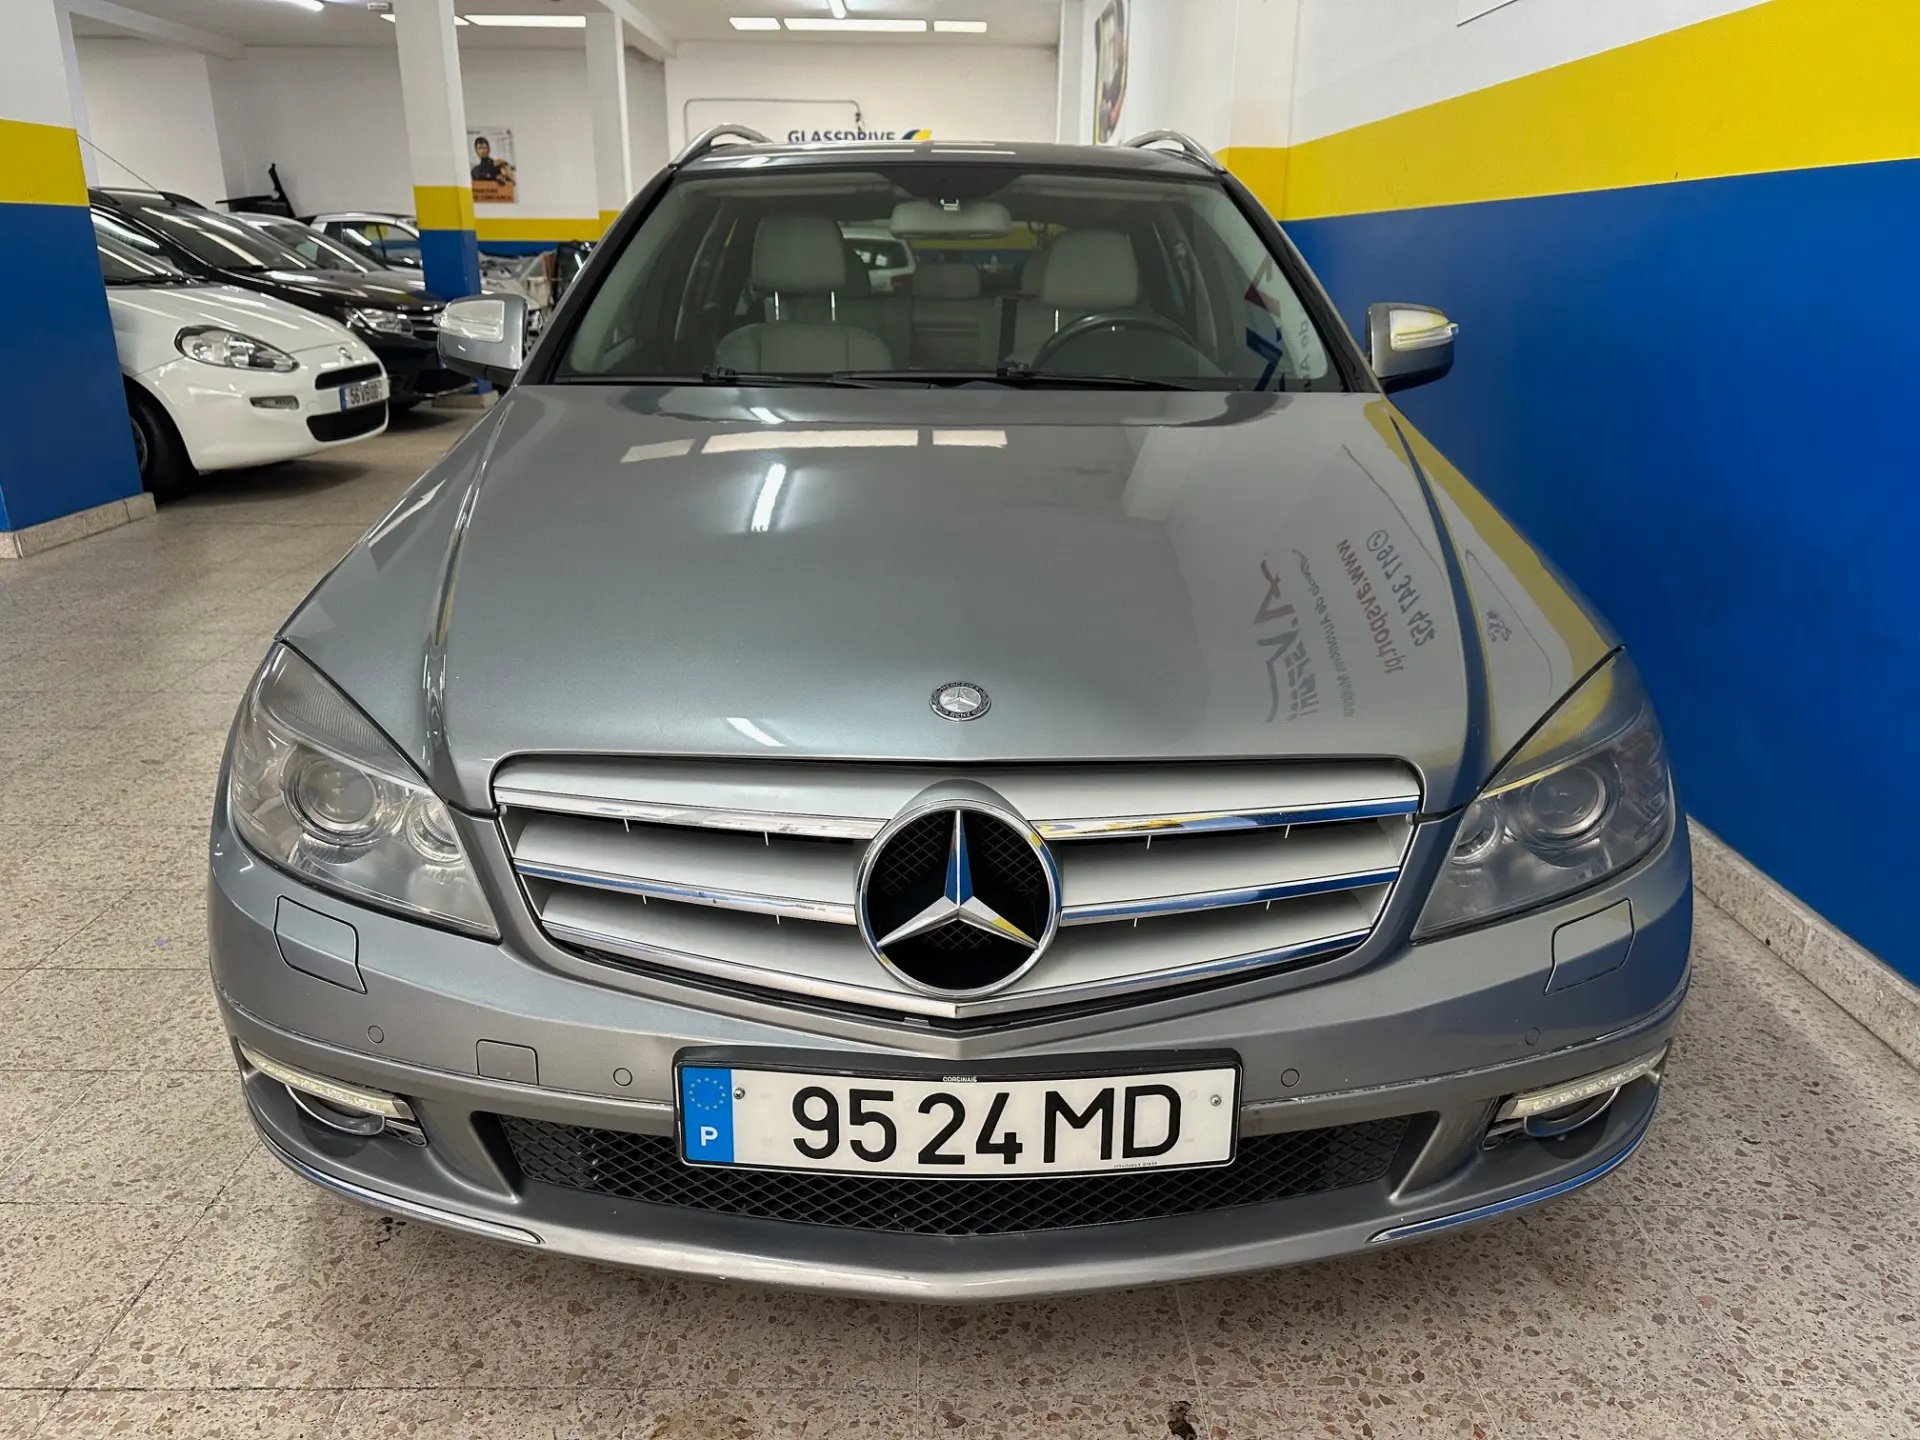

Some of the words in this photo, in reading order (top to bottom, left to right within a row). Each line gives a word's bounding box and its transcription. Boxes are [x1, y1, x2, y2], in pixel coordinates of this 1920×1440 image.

[700, 1126, 719, 1147] P
[792, 1085, 897, 1163] 95
[917, 1092, 1023, 1165] 24
[1043, 1083, 1182, 1164] MD
